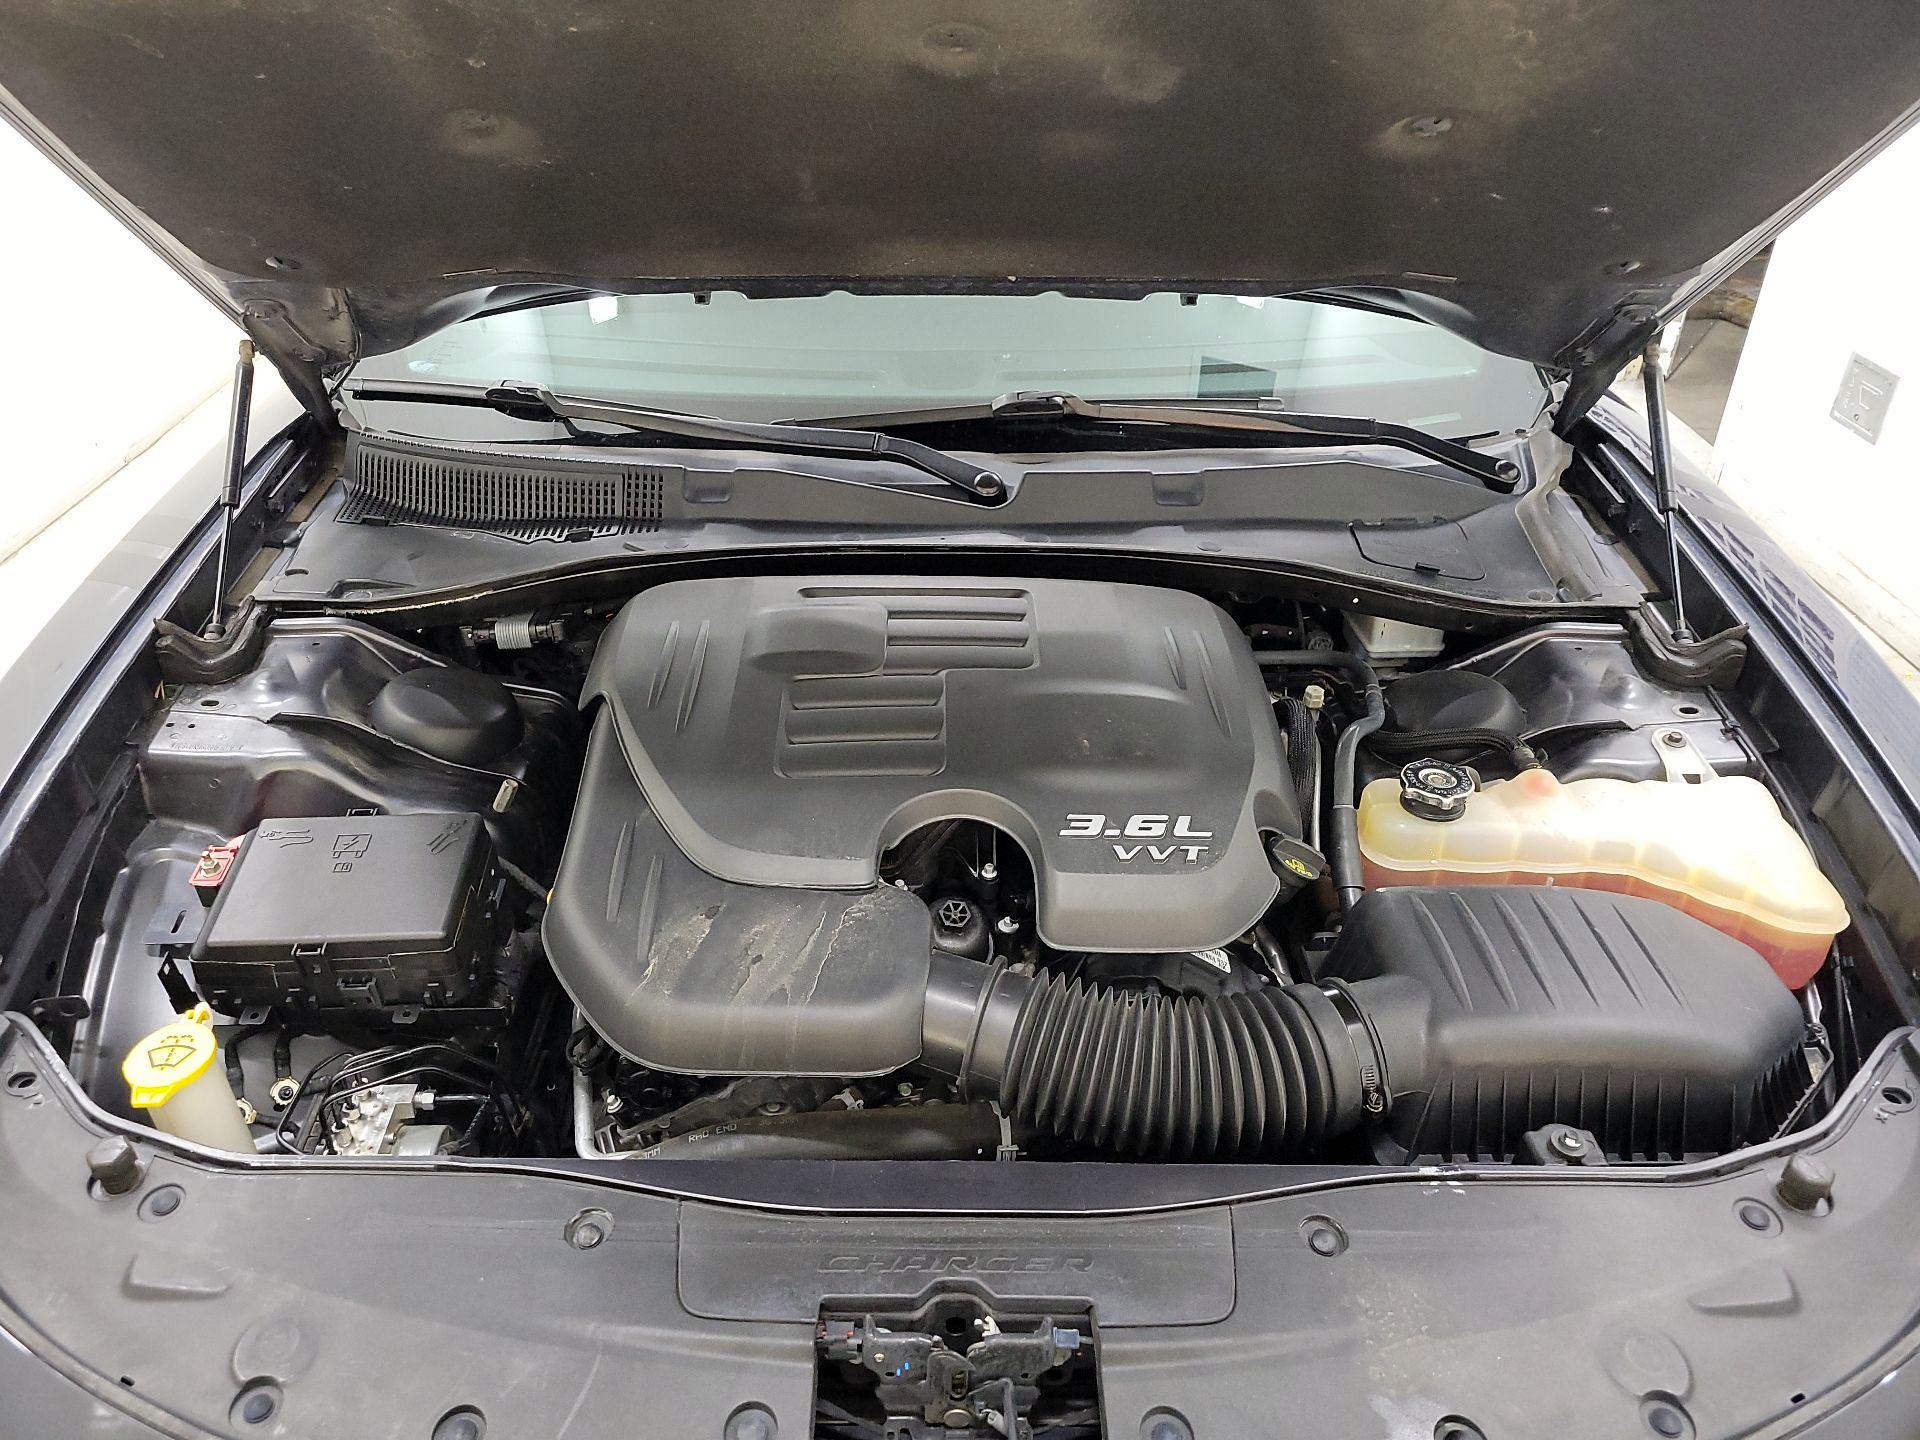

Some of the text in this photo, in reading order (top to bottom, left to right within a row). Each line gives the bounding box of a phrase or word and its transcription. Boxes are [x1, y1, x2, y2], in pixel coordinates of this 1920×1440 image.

[1059, 813, 1213, 840] 3.6L
[1112, 844, 1209, 865] VVT
[715, 1123, 738, 1135] END
[818, 1256, 1095, 1274] CHARGER
